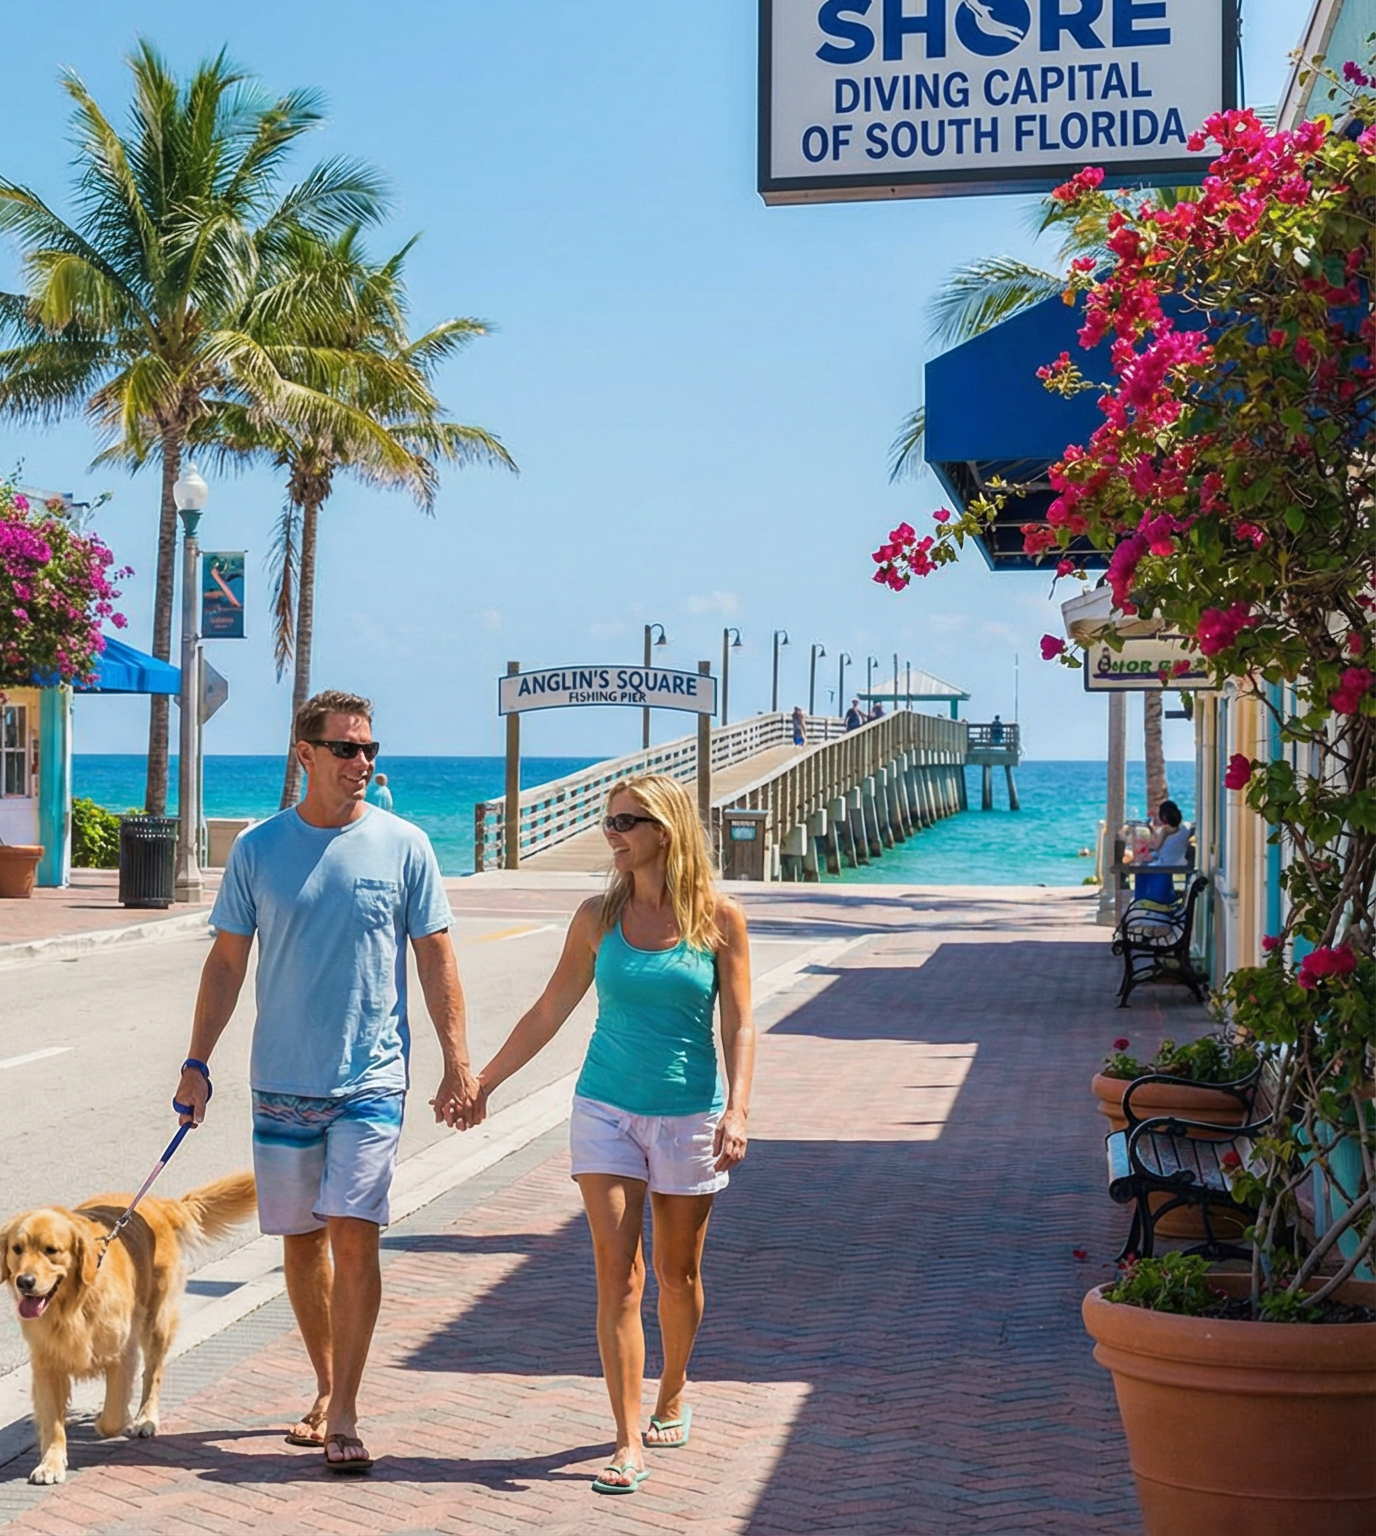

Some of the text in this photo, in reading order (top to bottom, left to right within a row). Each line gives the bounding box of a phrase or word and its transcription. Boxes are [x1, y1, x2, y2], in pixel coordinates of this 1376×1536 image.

[815, 0, 1171, 65] SHORE
[835, 62, 1154, 114] DIVING CAPITAL
[801, 107, 1188, 163] OF SOUTH FLORIDA
[517, 669, 698, 697] ANGLIN'S SQUARE
[568, 691, 647, 703] FISHING PIER
